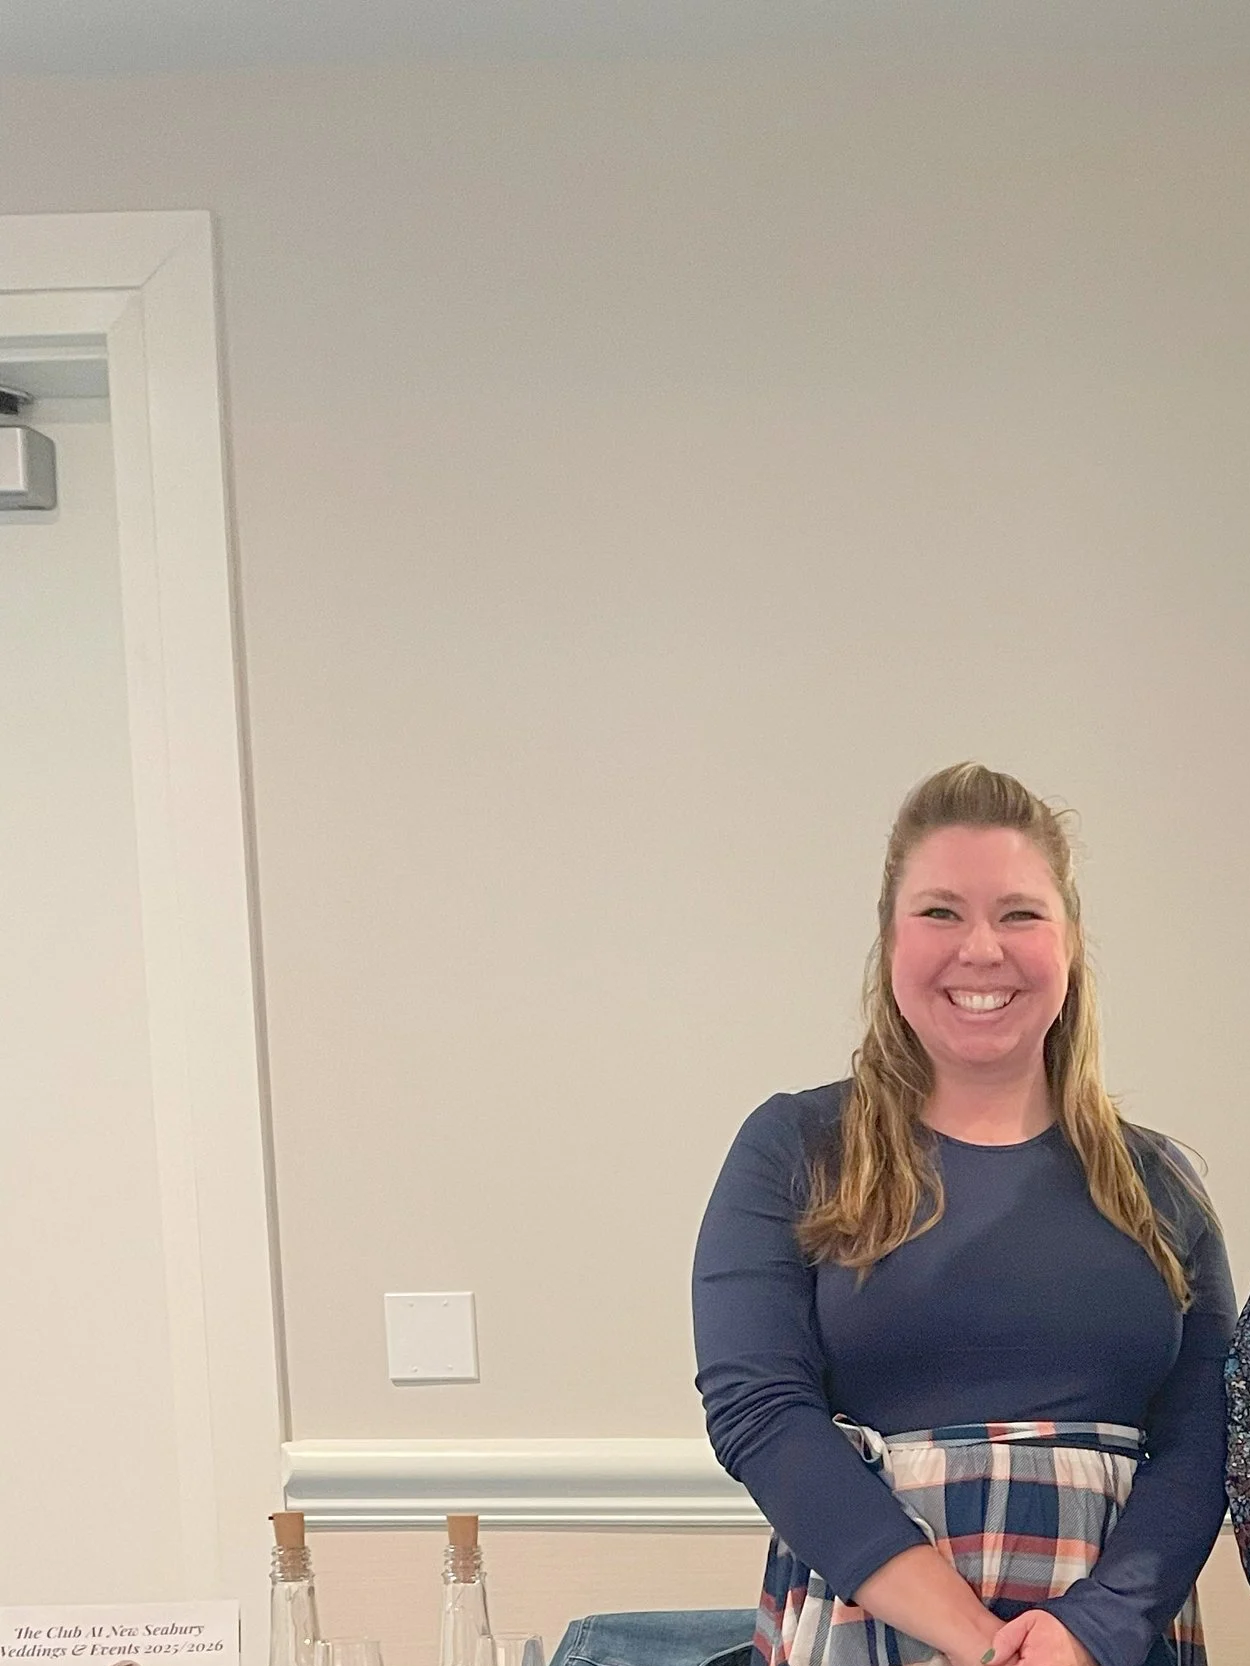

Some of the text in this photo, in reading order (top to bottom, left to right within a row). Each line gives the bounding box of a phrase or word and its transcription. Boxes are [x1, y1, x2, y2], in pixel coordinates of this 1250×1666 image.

[14, 1622, 205, 1640] The Club At New Seabury
[71, 1643, 88, 1656] &
[90, 1643, 141, 1656] Events
[143, 1639, 224, 1655] 2025/2026
